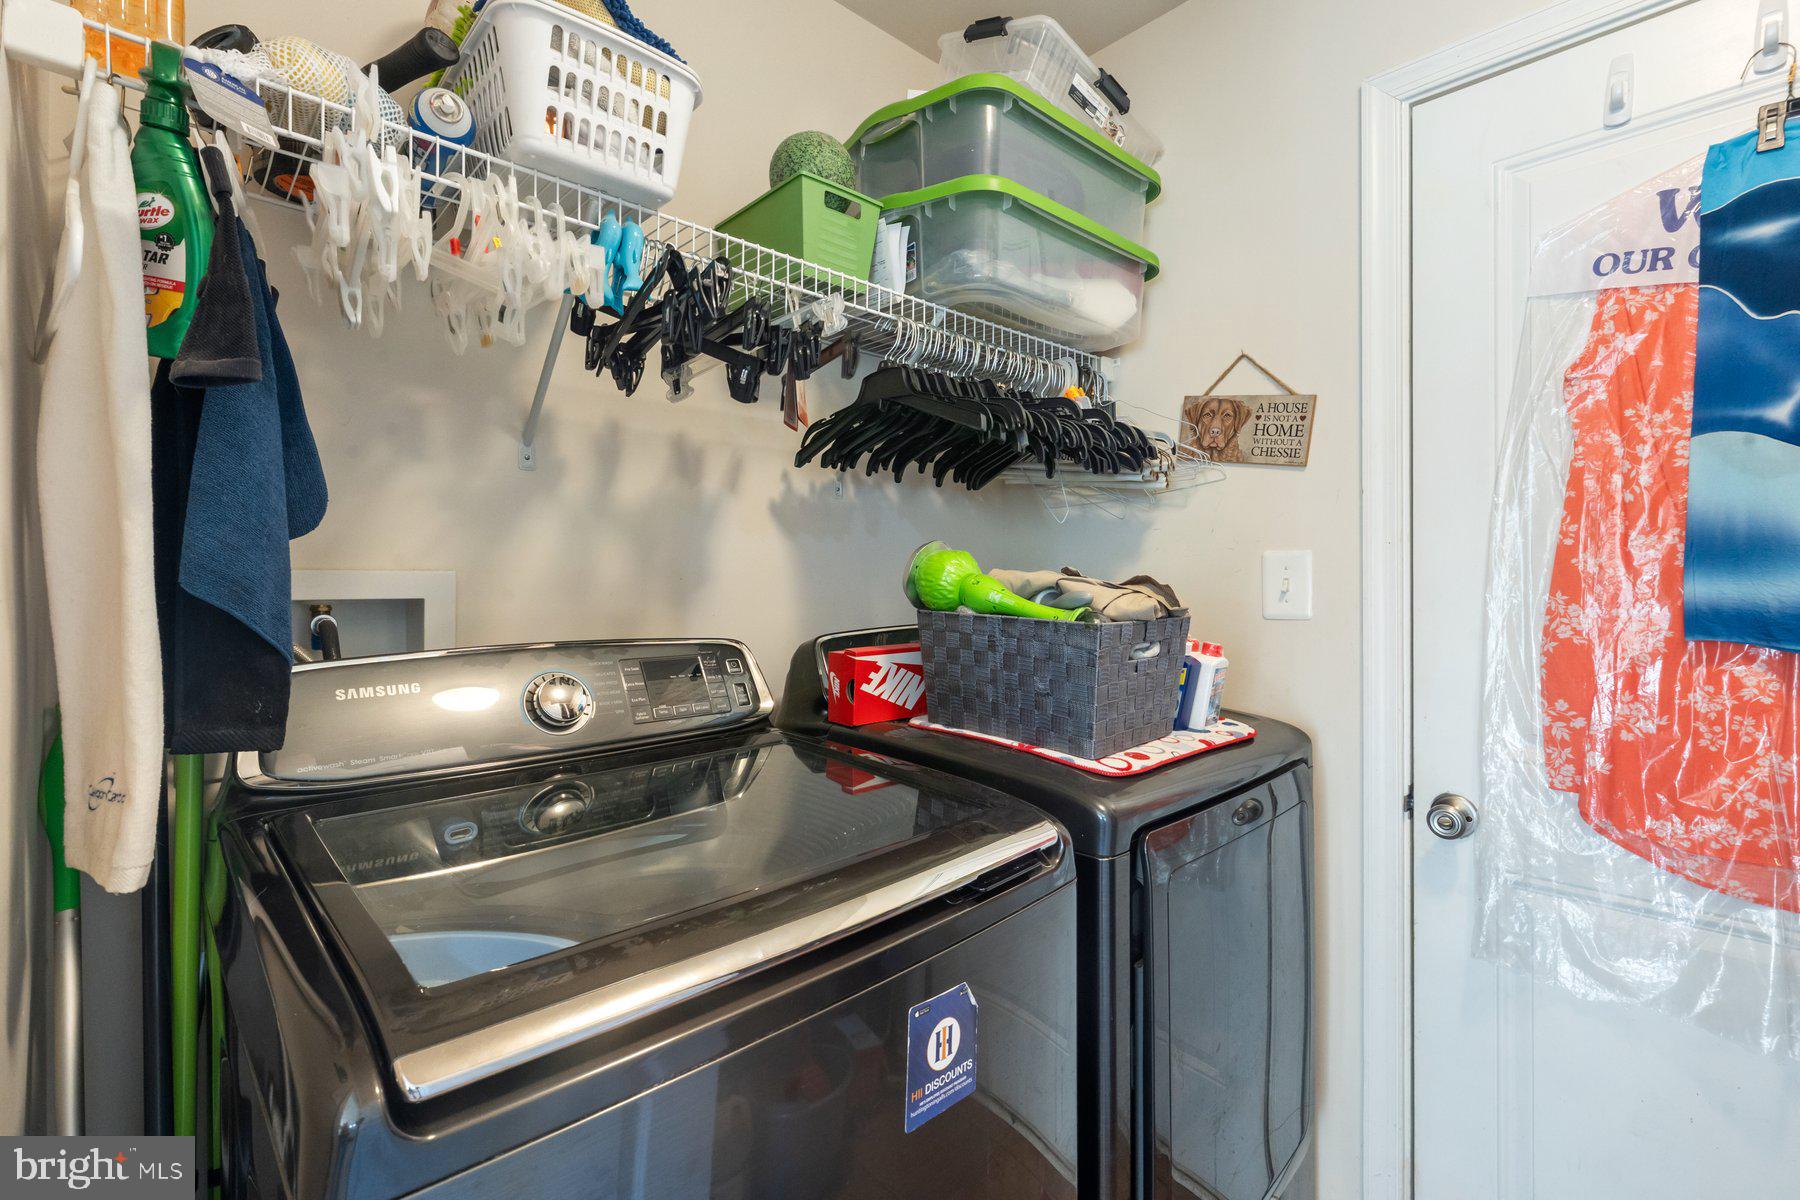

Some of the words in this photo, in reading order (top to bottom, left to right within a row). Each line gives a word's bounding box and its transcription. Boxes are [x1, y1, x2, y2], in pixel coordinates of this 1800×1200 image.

[138, 206, 170, 217] urtle
[143, 249, 169, 265] TAR
[1592, 246, 1675, 277] OUR
[1256, 403, 1265, 413] A
[1268, 403, 1308, 413] HOUSE
[1254, 424, 1305, 437] HOME
[1253, 438, 1295, 446] WITHOUT
[1251, 447, 1301, 458] CHESSIE
[335, 682, 421, 701] SAMSUNG
[860, 661, 926, 711] NIKE
[350, 757, 376, 766] Steam
[911, 1088, 923, 1103] HII
[925, 1059, 973, 1095] DISCOUNTS
